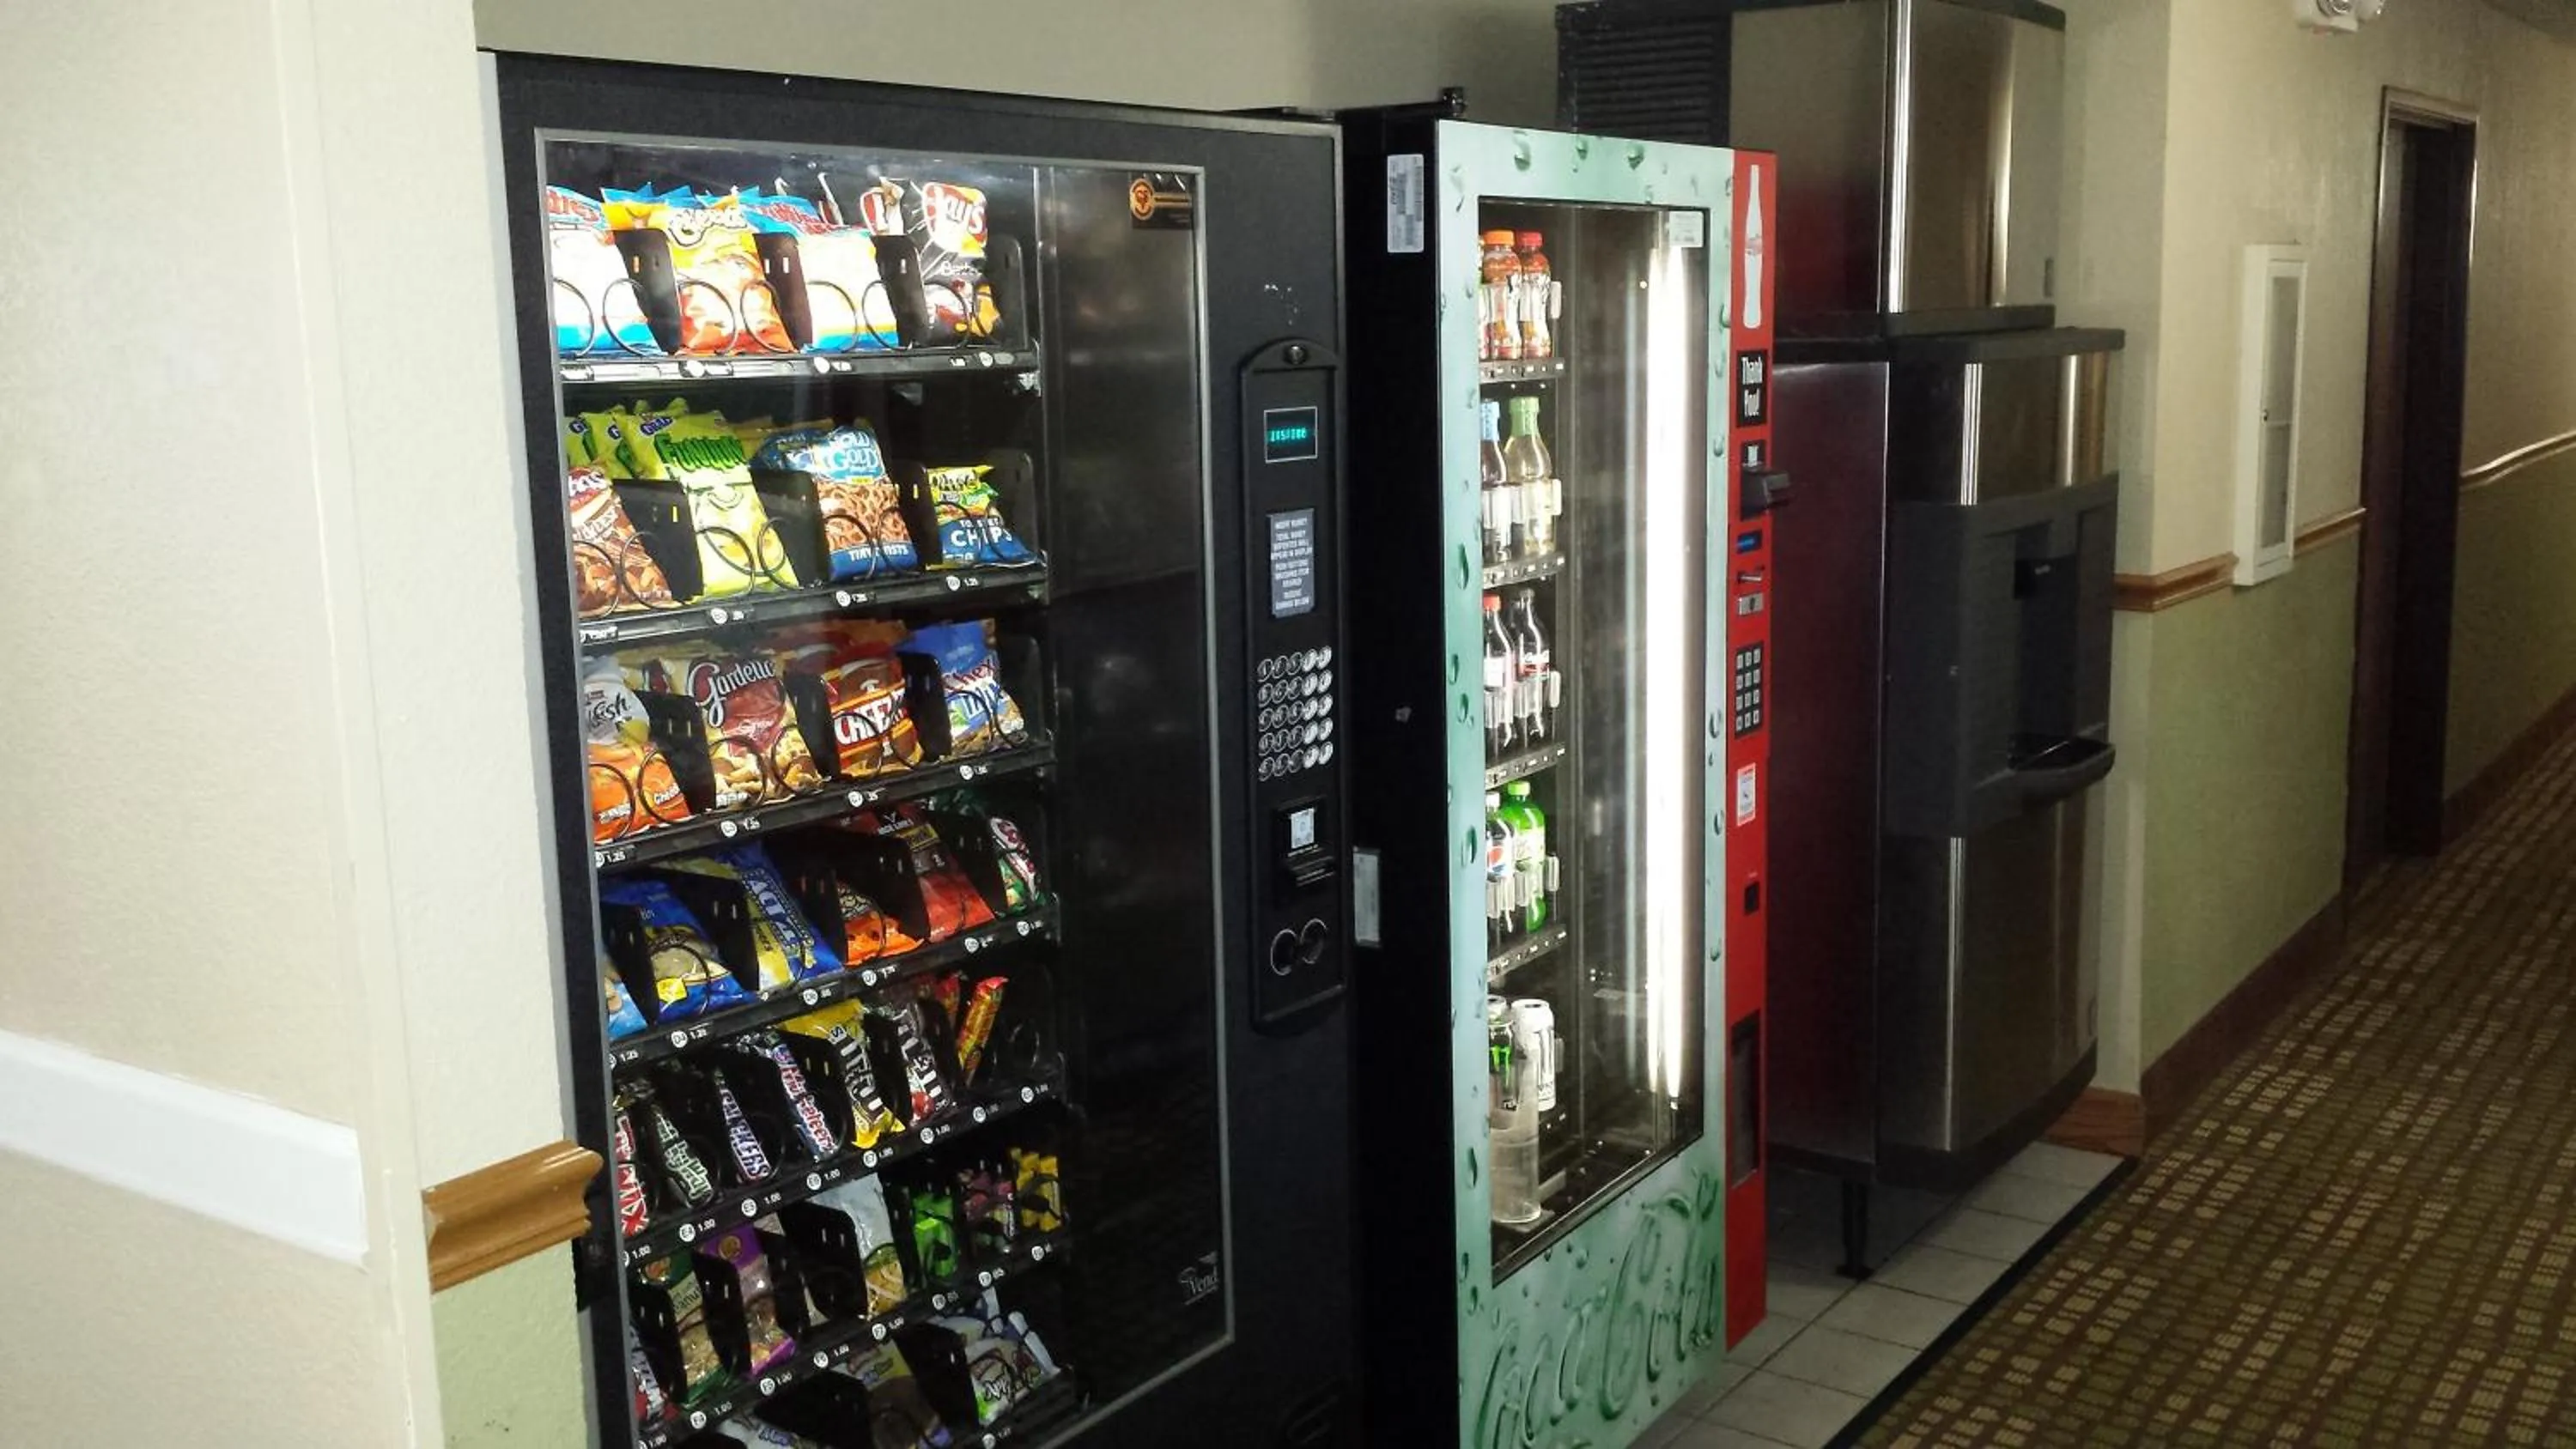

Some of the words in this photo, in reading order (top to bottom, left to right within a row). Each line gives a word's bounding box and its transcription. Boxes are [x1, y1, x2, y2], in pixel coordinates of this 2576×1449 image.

[1741, 355, 1763, 385] Thank
[1744, 388, 1759, 416] You!
[951, 526, 1012, 547] CHIPS
[824, 1168, 841, 1180] 1.00
[764, 1192, 782, 1204] 1.00
[697, 1218, 716, 1232] 1.00
[631, 1244, 651, 1259] 1.00
[834, 1343, 850, 1357] 1.00
[775, 1371, 793, 1385] 1.00
[714, 1401, 732, 1416] 1.00
[647, 1433, 667, 1448] 1.00
